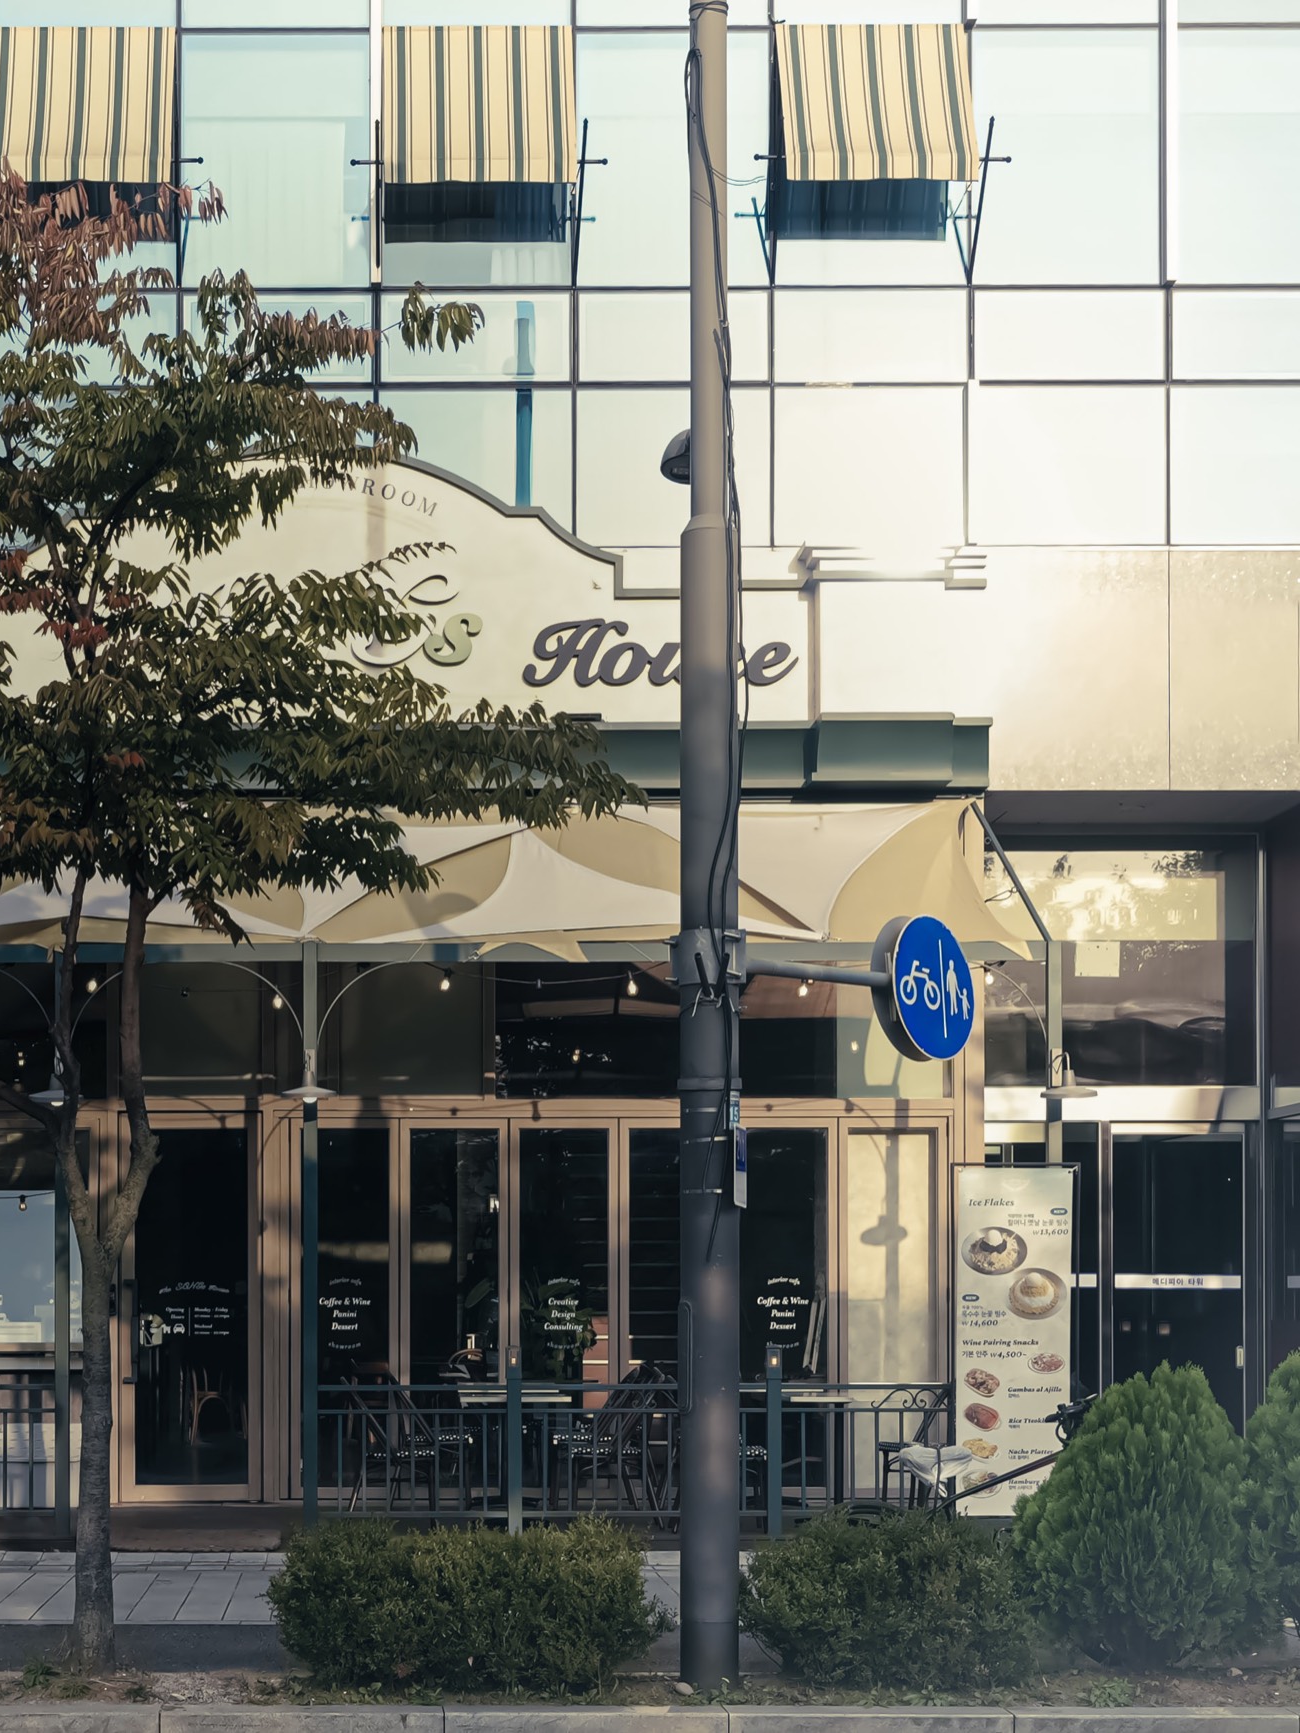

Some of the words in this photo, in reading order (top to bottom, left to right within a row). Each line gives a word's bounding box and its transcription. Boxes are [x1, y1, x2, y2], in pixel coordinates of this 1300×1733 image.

[522, 617, 799, 688] Houe
[968, 1198, 983, 1207] Ice
[984, 1198, 1015, 1207] Flakes
[1152, 1277, 1184, 1286] 메디피아
[1187, 1277, 1204, 1286] 타워
[319, 1296, 343, 1308] Coffee
[343, 1297, 351, 1306] &
[352, 1297, 371, 1306] Wine
[548, 1297, 579, 1306] Creative
[757, 1296, 781, 1308] Coffee
[781, 1296, 789, 1305] &
[790, 1296, 810, 1305] Wine
[333, 1309, 357, 1318] Panini
[551, 1309, 576, 1320] Design
[771, 1309, 796, 1318] Panini
[331, 1322, 358, 1330] Dessert
[544, 1322, 583, 1332] Consulting
[769, 1321, 797, 1330] Dessert
[328, 1341, 362, 1350] showroom
[983, 1339, 1012, 1347] Pairing
[961, 1350, 975, 1358] 기본
[975, 1350, 989, 1358] 안주
[1044, 1386, 1063, 1394] Ajillo
